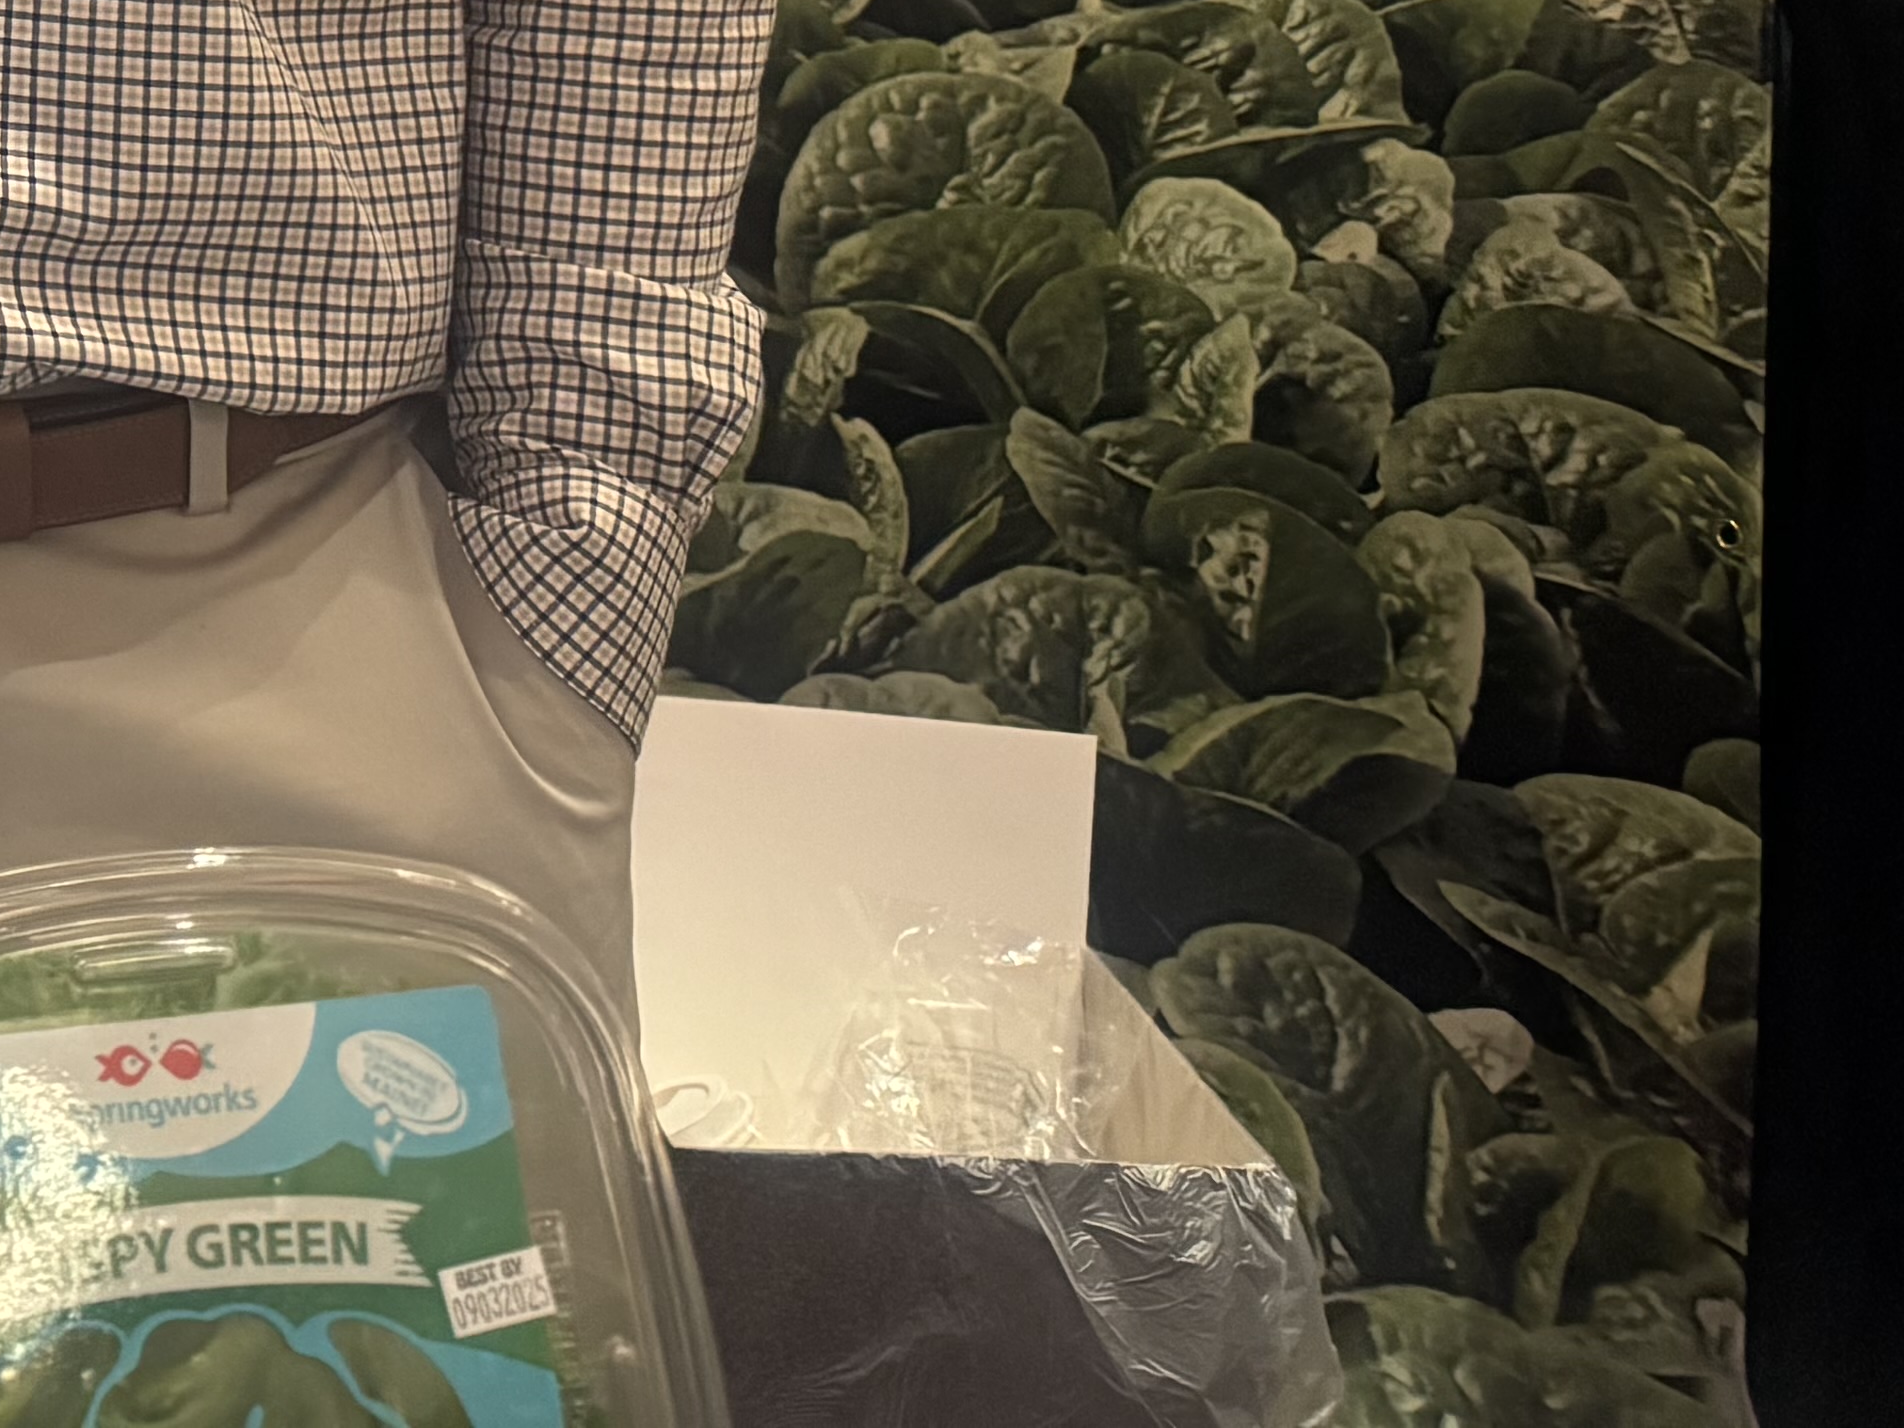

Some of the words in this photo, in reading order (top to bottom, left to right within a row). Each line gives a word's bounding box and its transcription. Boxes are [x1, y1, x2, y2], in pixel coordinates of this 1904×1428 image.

[186, 1221, 369, 1269] GREEN
[455, 1262, 497, 1291] BEST
[500, 1256, 522, 1279] BY
[452, 1274, 550, 1330] 09032025
